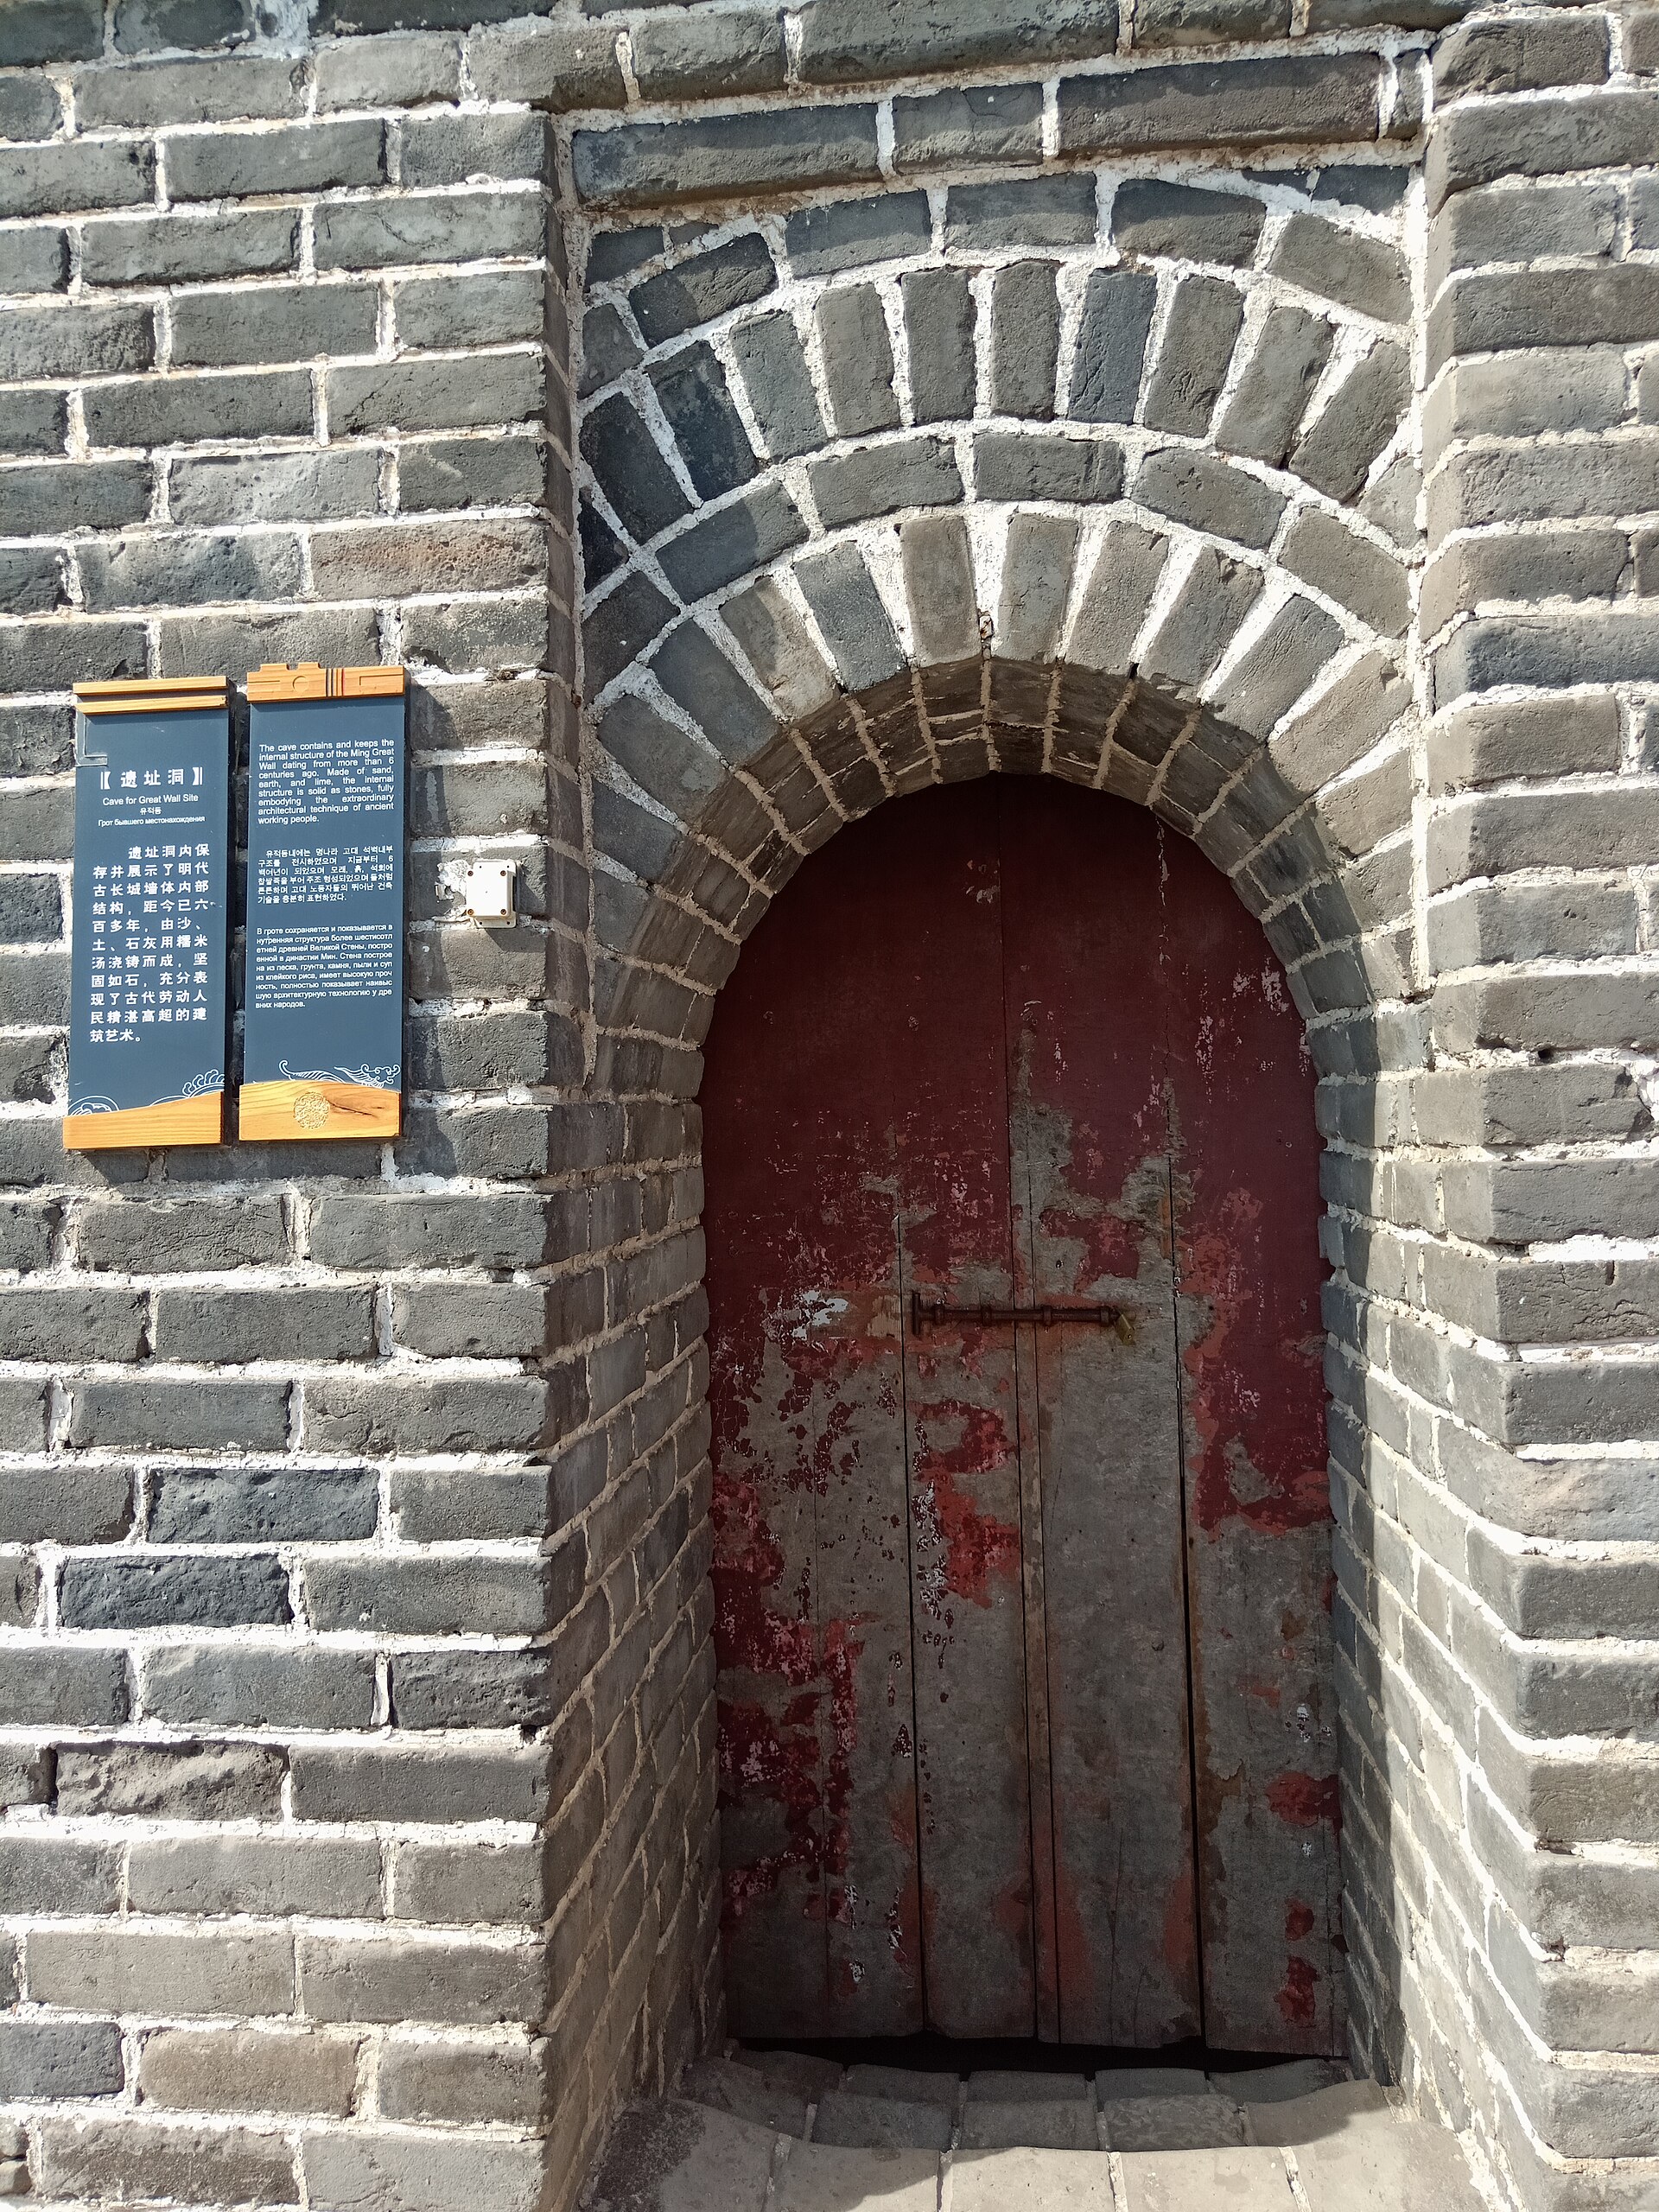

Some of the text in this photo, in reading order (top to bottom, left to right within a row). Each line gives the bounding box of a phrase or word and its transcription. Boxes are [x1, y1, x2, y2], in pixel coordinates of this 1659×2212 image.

[351, 749, 369, 758] Ming
[283, 761, 306, 770] dating
[302, 769, 319, 779] ago.
[163, 794, 181, 803] Wall
[183, 793, 198, 802] Site
[258, 798, 301, 806] embodying
[310, 804, 348, 813] technique
[145, 817, 205, 825] местонахождения
[258, 815, 319, 824] working people.
[128, 844, 210, 860] 遗址洞内保
[93, 861, 209, 880] 存并展示了明代
[93, 880, 209, 897] 古长城墙体内部
[91, 989, 207, 1006] 现了古代劳动人
[91, 1007, 207, 1024] 民精湛高超的建
[90, 1029, 141, 1043] 筑艺术。
